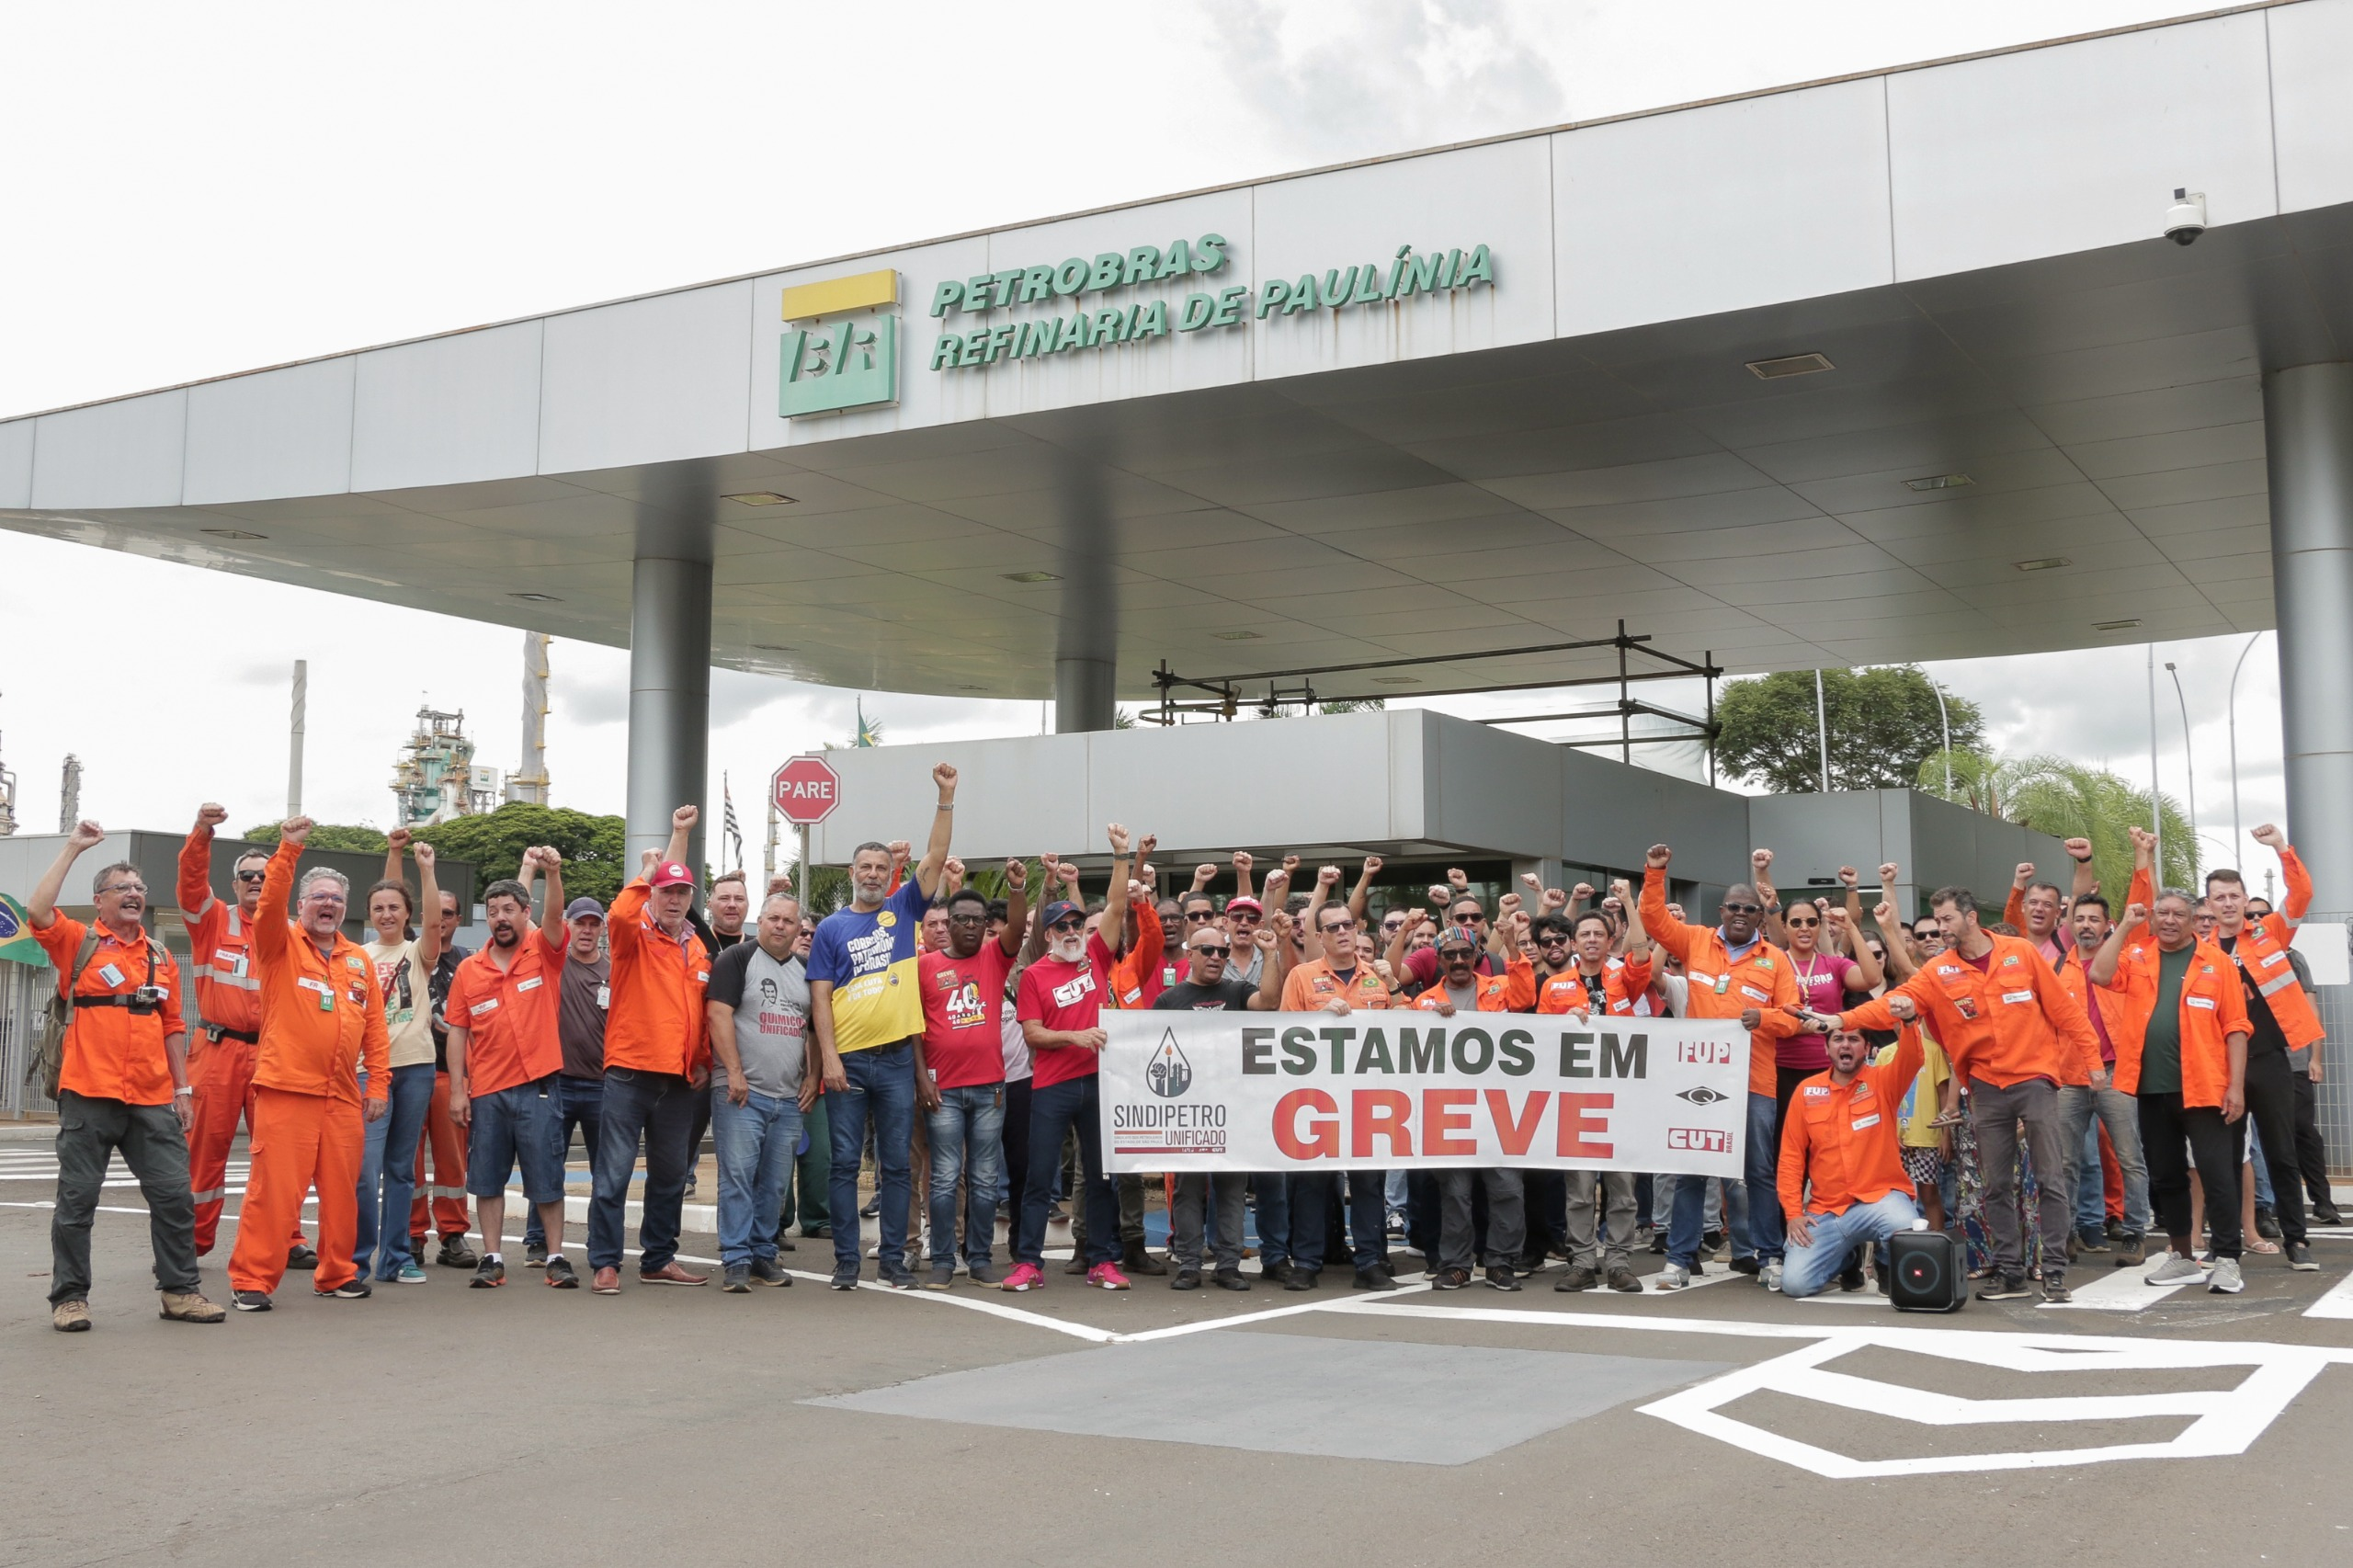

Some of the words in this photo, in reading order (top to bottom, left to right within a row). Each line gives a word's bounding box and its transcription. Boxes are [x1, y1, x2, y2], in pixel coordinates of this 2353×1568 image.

[929, 233, 1227, 318] PETROBRAS
[929, 300, 1167, 371] REFINARIA
[1177, 285, 1247, 333] DE
[1256, 244, 1493, 320] PAULÍNIA
[789, 314, 883, 383] BR
[779, 780, 833, 799] PARE
[946, 982, 980, 1014] 40
[1055, 974, 1092, 1002] CUT
[1552, 981, 1576, 990] FUP
[1242, 1027, 1536, 1076] ESTAMOS
[1559, 1031, 1648, 1079] EM
[1678, 1041, 1731, 1064] FUP
[1804, 1086, 1829, 1096] FUP
[1114, 1105, 1226, 1128] SINDIPETRO
[1272, 1088, 1615, 1160] GREVE
[1165, 1130, 1226, 1146] UNIFICADO
[1668, 1128, 1725, 1152] CUT
[1725, 1131, 1734, 1154] BRASIL
